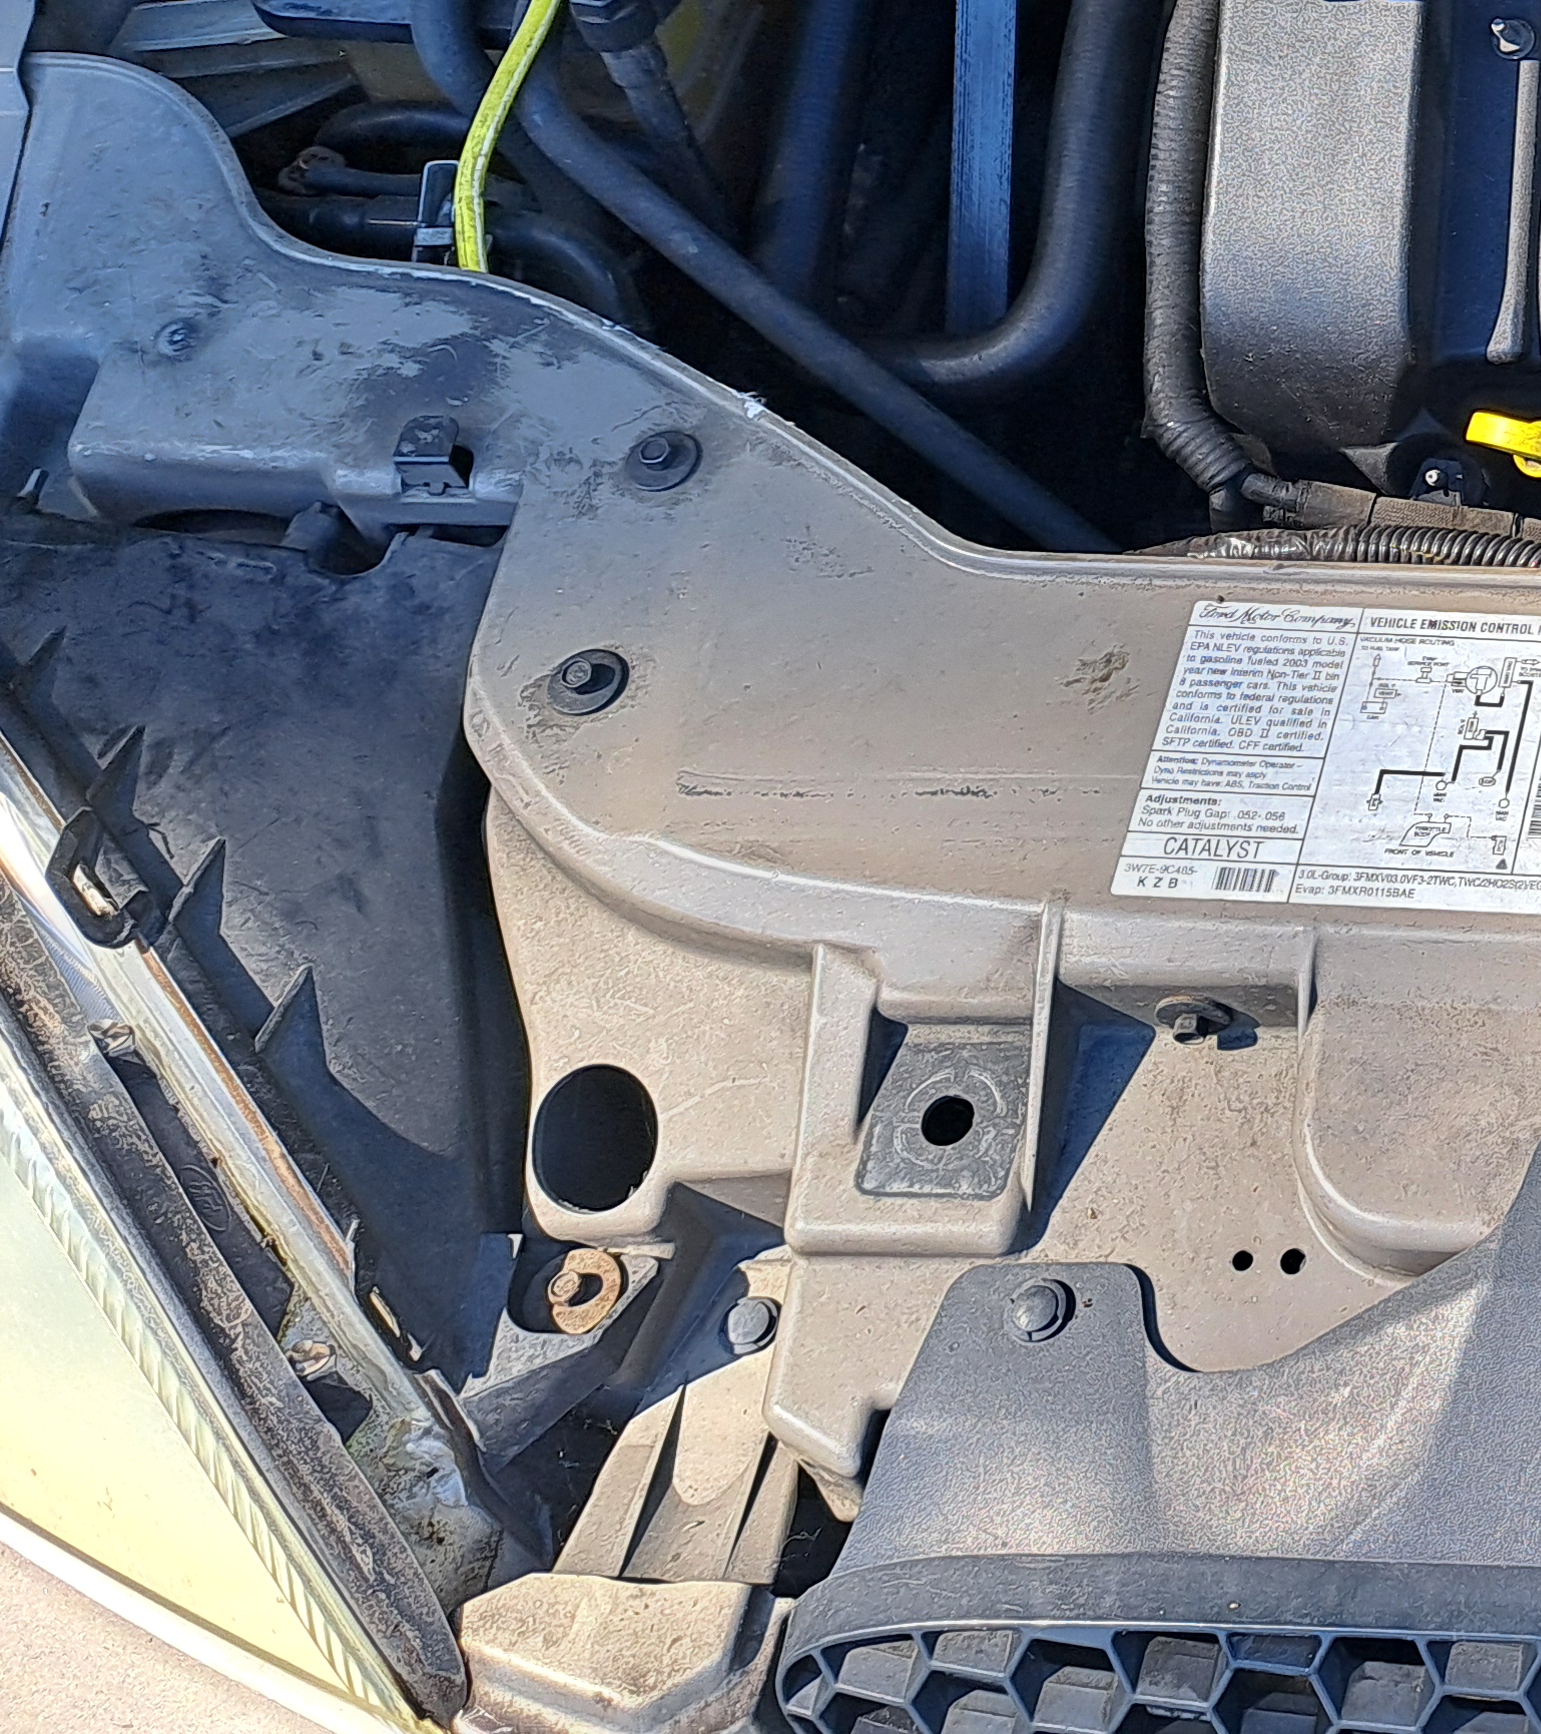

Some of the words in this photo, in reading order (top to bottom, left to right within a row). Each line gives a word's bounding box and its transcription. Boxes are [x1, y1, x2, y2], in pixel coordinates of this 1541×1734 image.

[1199, 604, 1237, 621] Ford
[1234, 606, 1281, 624] Motor
[1281, 607, 1355, 630] Company
[1370, 616, 1417, 630] VEHICLE
[1420, 619, 1476, 633] EMISSION
[1480, 622, 1534, 635] CONTROL
[1194, 630, 1215, 639] This
[1220, 632, 1255, 641] vehicle
[1260, 633, 1307, 644] conforms
[1327, 636, 1349, 646] U.S.
[1190, 641, 1210, 652] EPA
[1212, 642, 1240, 652] NLEV
[1200, 655, 1243, 666] gasoline
[1282, 658, 1308, 667] 2003
[1312, 660, 1344, 669] model
[1183, 667, 1205, 676] year
[1190, 678, 1244, 690] passenger
[1247, 681, 1271, 689] cars.
[1276, 681, 1297, 691] This
[1301, 683, 1338, 692] vehicle
[1176, 689, 1222, 700] conforms
[1239, 692, 1275, 702] federal
[1278, 694, 1334, 705] regulations
[1172, 701, 1192, 710] and
[1216, 703, 1262, 714] certified
[1291, 707, 1314, 716] sale
[1169, 712, 1223, 724] California.
[1230, 715, 1261, 726] ULEV
[1266, 717, 1313, 731] qualified
[1166, 724, 1221, 737] California.
[1228, 727, 1253, 737] OBD
[1276, 730, 1324, 741] certified.
[1162, 737, 1190, 747] SFTP
[1238, 740, 1260, 750] CFF
[1145, 794, 1223, 807] Adjustments:
[1141, 805, 1173, 816] Spark
[1176, 807, 1200, 818] Plug
[1204, 809, 1230, 820] Gap:
[1138, 817, 1153, 827] No
[1156, 818, 1185, 829] other
[1187, 820, 1253, 832] adjustments
[1256, 823, 1299, 834] needed.
[1163, 836, 1265, 858] CATALYST
[1295, 884, 1325, 895] Evap:
